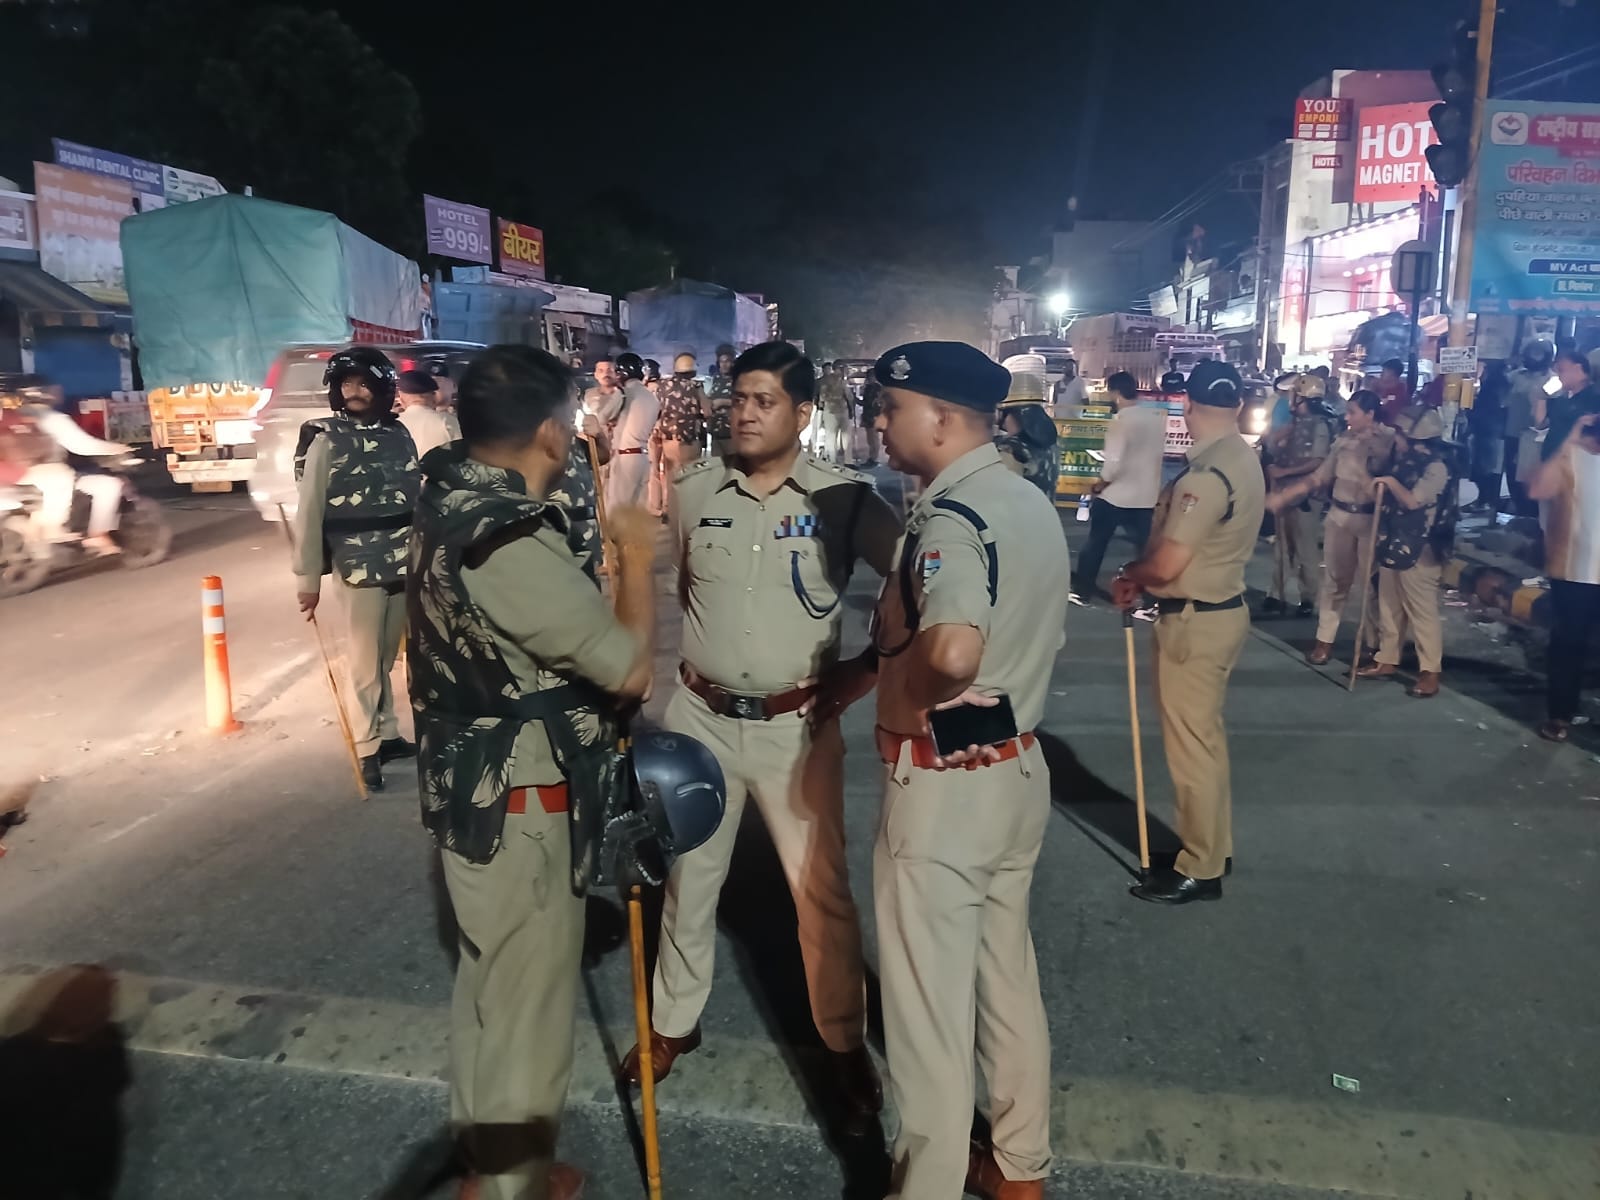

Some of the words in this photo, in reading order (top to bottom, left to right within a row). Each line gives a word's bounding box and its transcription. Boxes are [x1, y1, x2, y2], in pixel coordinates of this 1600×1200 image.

[1303, 99, 1340, 113] YOU
[1360, 120, 1434, 160] HOT
[95, 158, 132, 179] DENTAL
[132, 167, 161, 185] CLINIC
[1359, 162, 1422, 186] MAGNET
[437, 207, 480, 226] HOTEL
[1550, 262, 1568, 272] MV
[1569, 263, 1587, 273] Act
